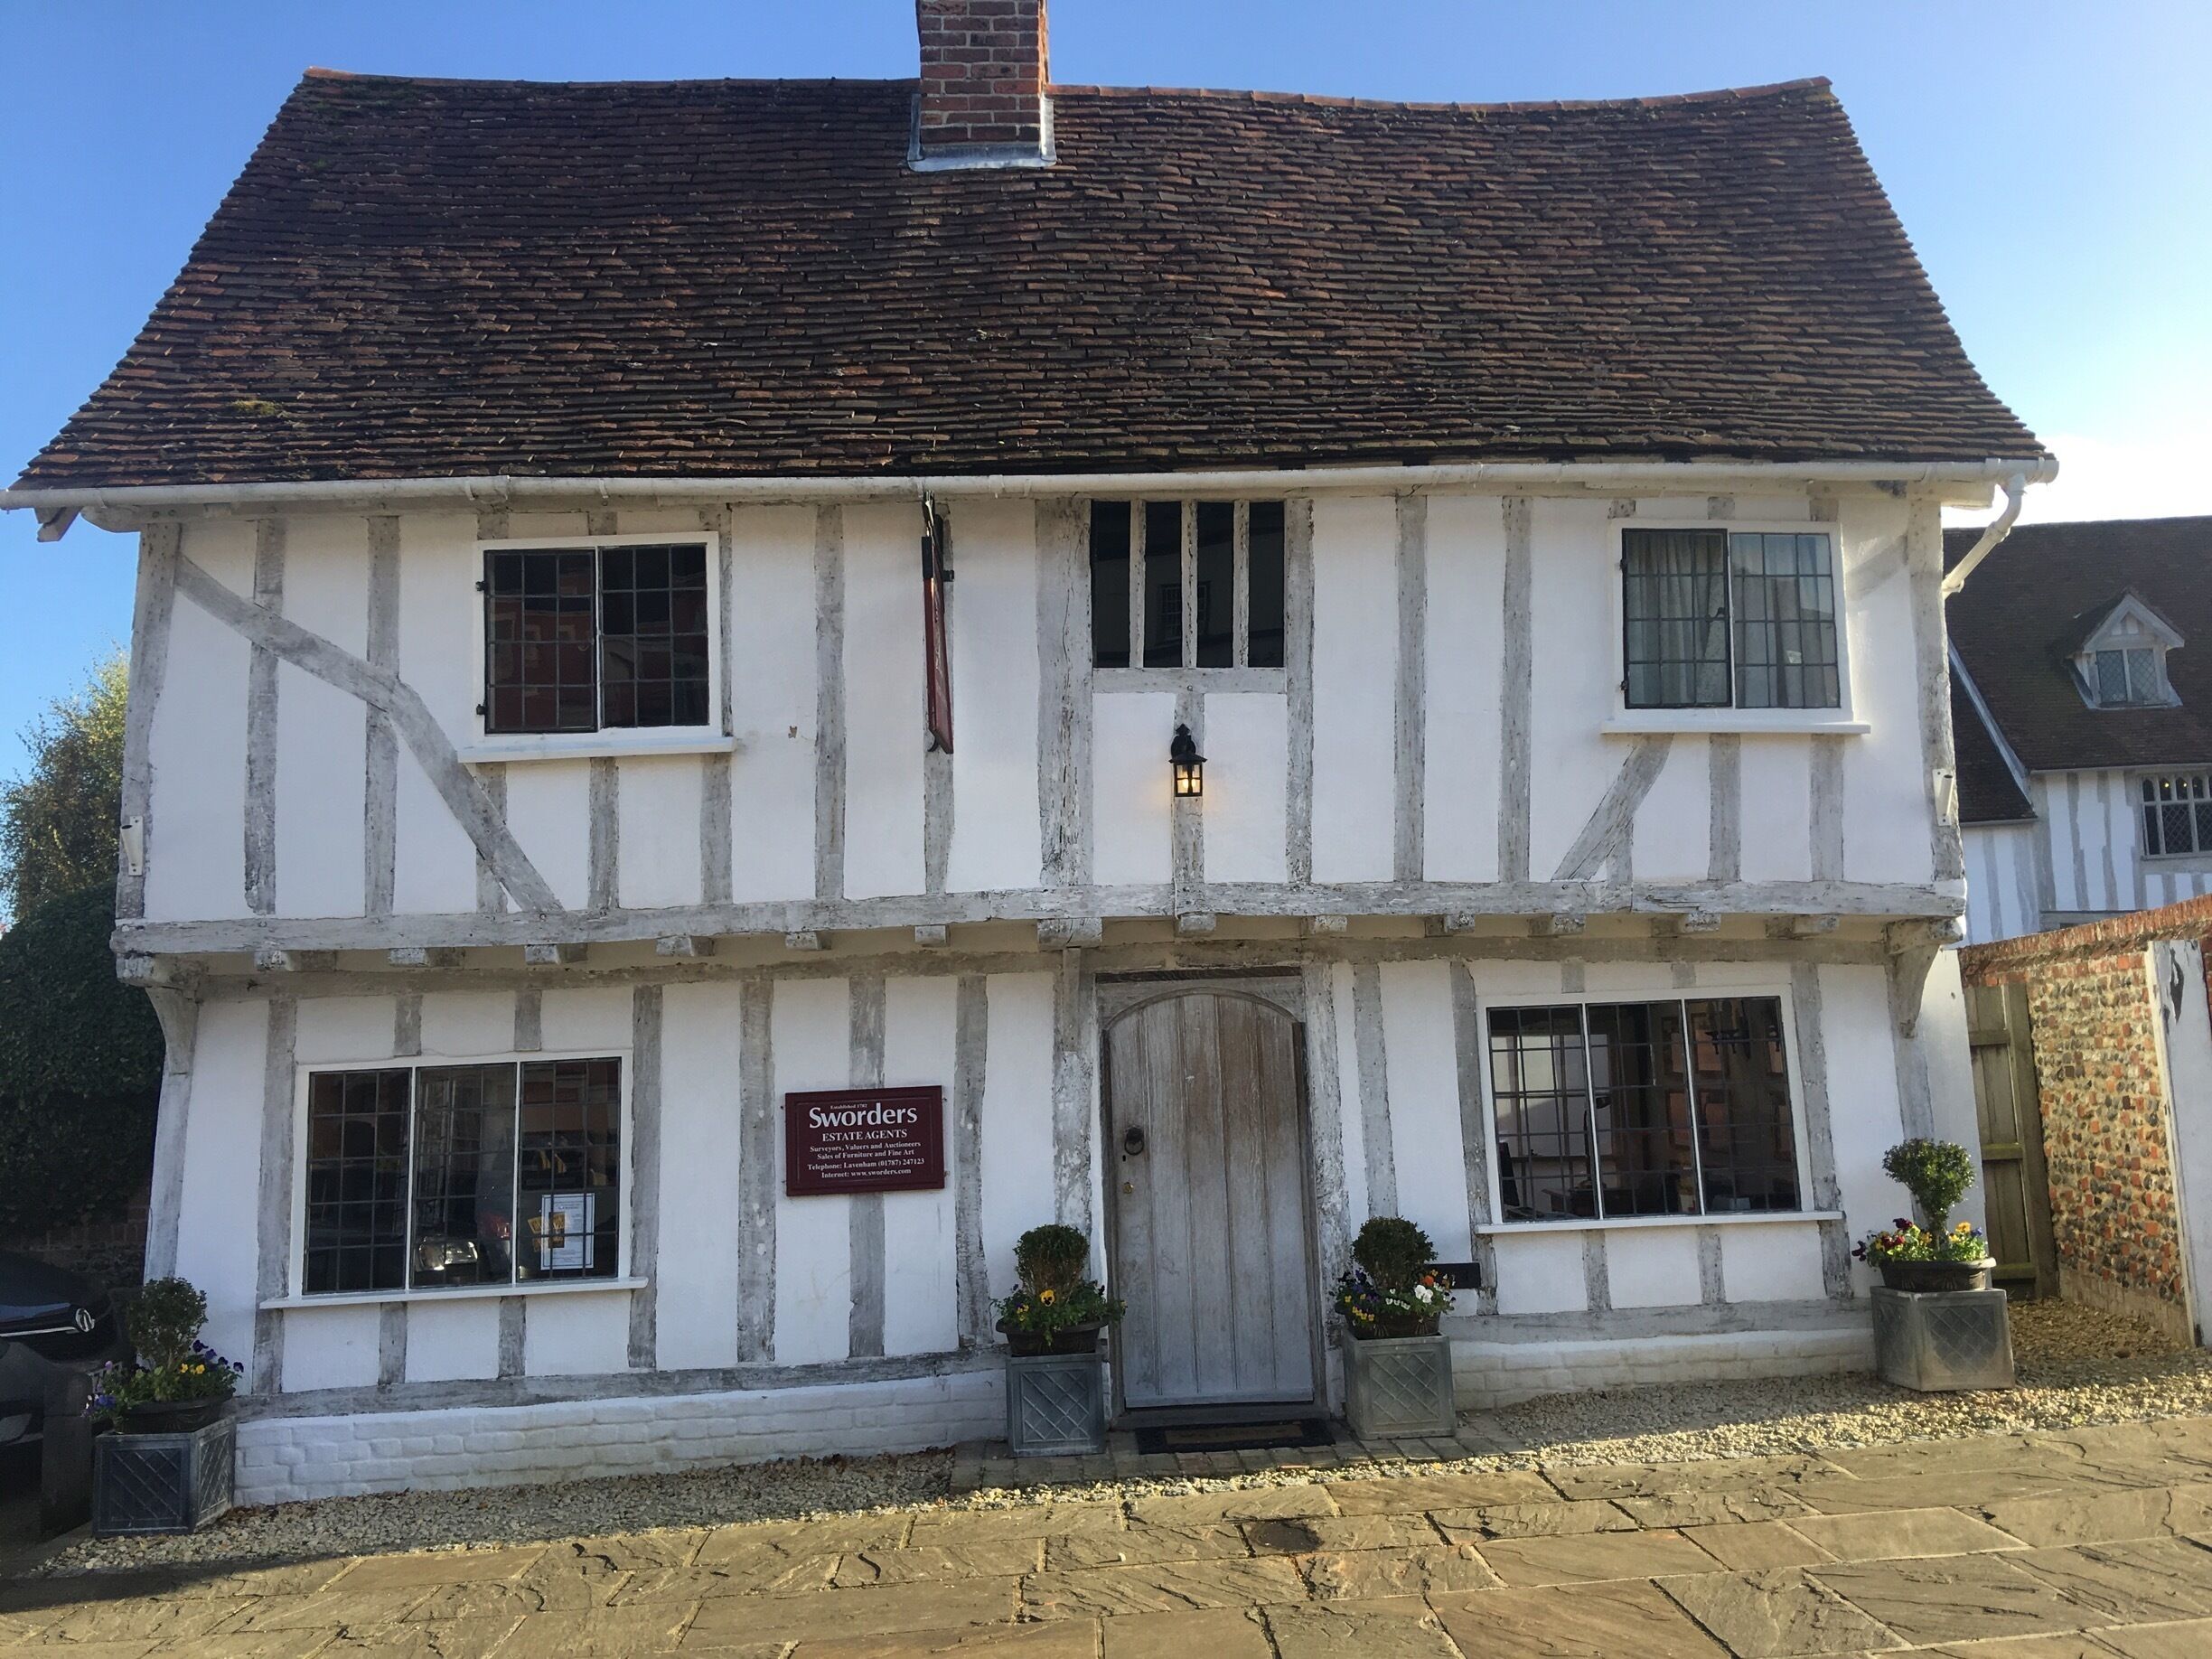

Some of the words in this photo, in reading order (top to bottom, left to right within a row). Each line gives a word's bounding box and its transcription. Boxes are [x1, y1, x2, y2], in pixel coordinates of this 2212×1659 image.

[810, 1102, 917, 1129] Sworders
[822, 1133, 863, 1141] ESTATE
[865, 1129, 907, 1139] AGENTS
